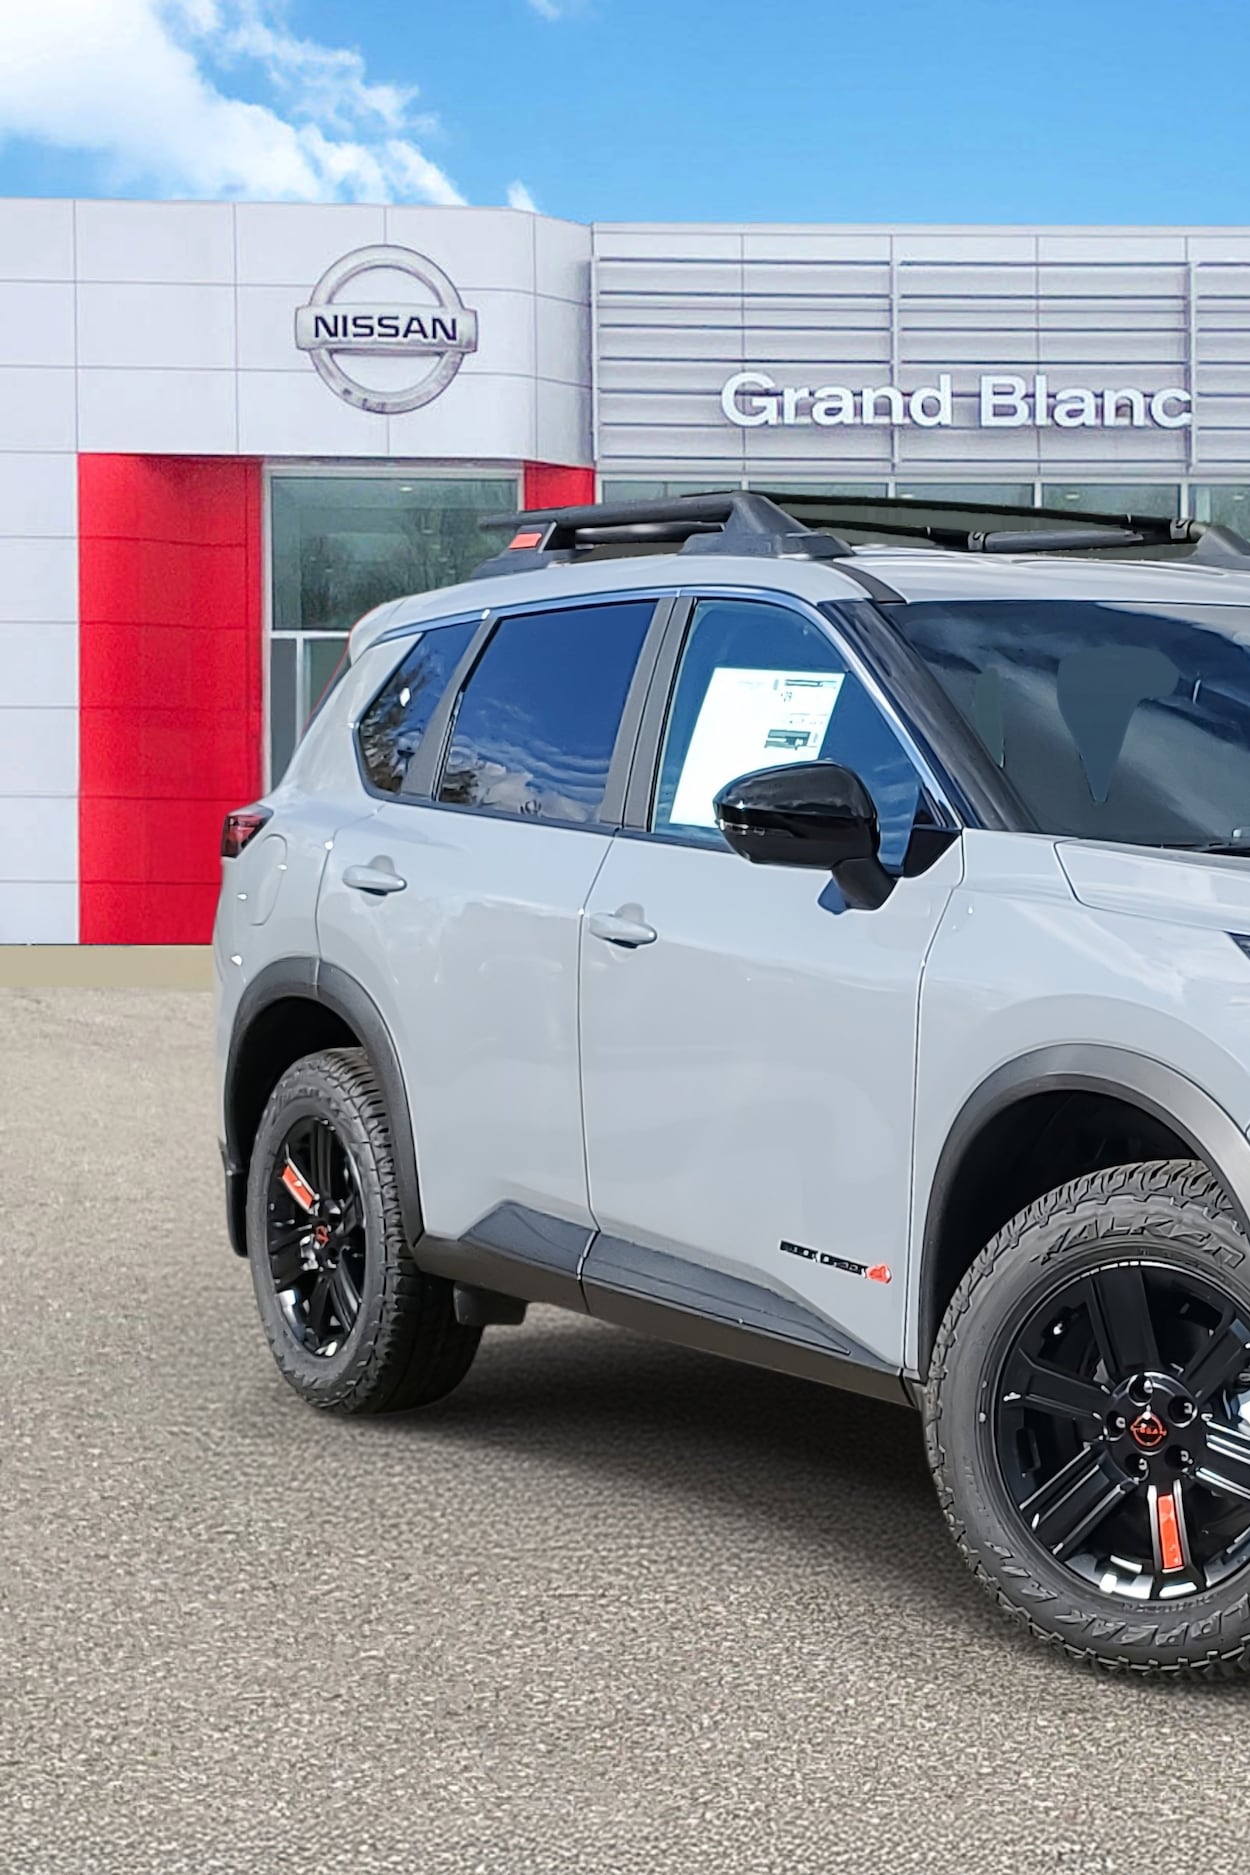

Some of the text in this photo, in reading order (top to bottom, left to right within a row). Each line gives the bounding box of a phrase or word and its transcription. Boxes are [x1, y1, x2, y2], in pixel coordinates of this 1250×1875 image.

[314, 314, 457, 341] NISSAN
[720, 372, 1192, 429] Grand Blanc
